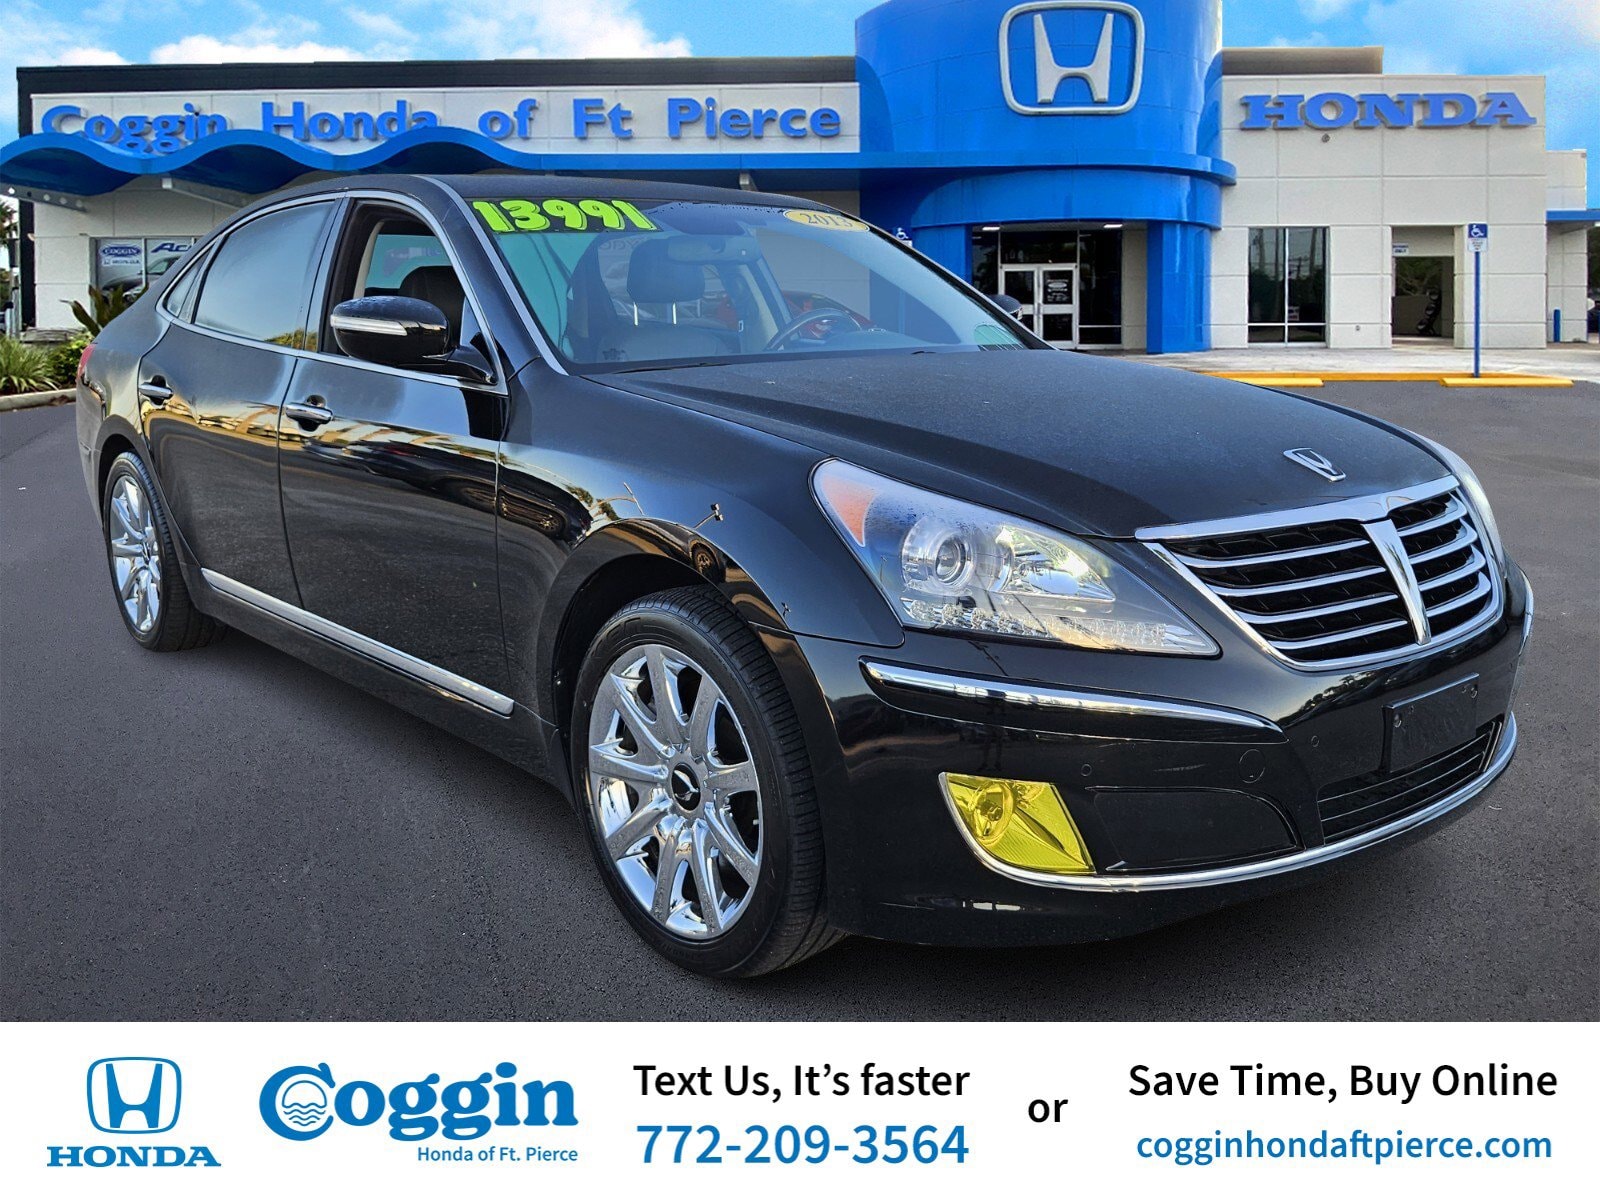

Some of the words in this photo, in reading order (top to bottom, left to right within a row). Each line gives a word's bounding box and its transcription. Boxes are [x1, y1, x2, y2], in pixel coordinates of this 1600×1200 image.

[41, 102, 229, 153] Coggin
[261, 99, 440, 142] Honda
[477, 98, 538, 140] of
[573, 97, 633, 140] Ft
[668, 96, 842, 138] Pierce
[1240, 92, 1538, 130] HONDA
[472, 199, 657, 232] 13991
[799, 211, 854, 228] 2013
[104, 246, 138, 255] COGGIN
